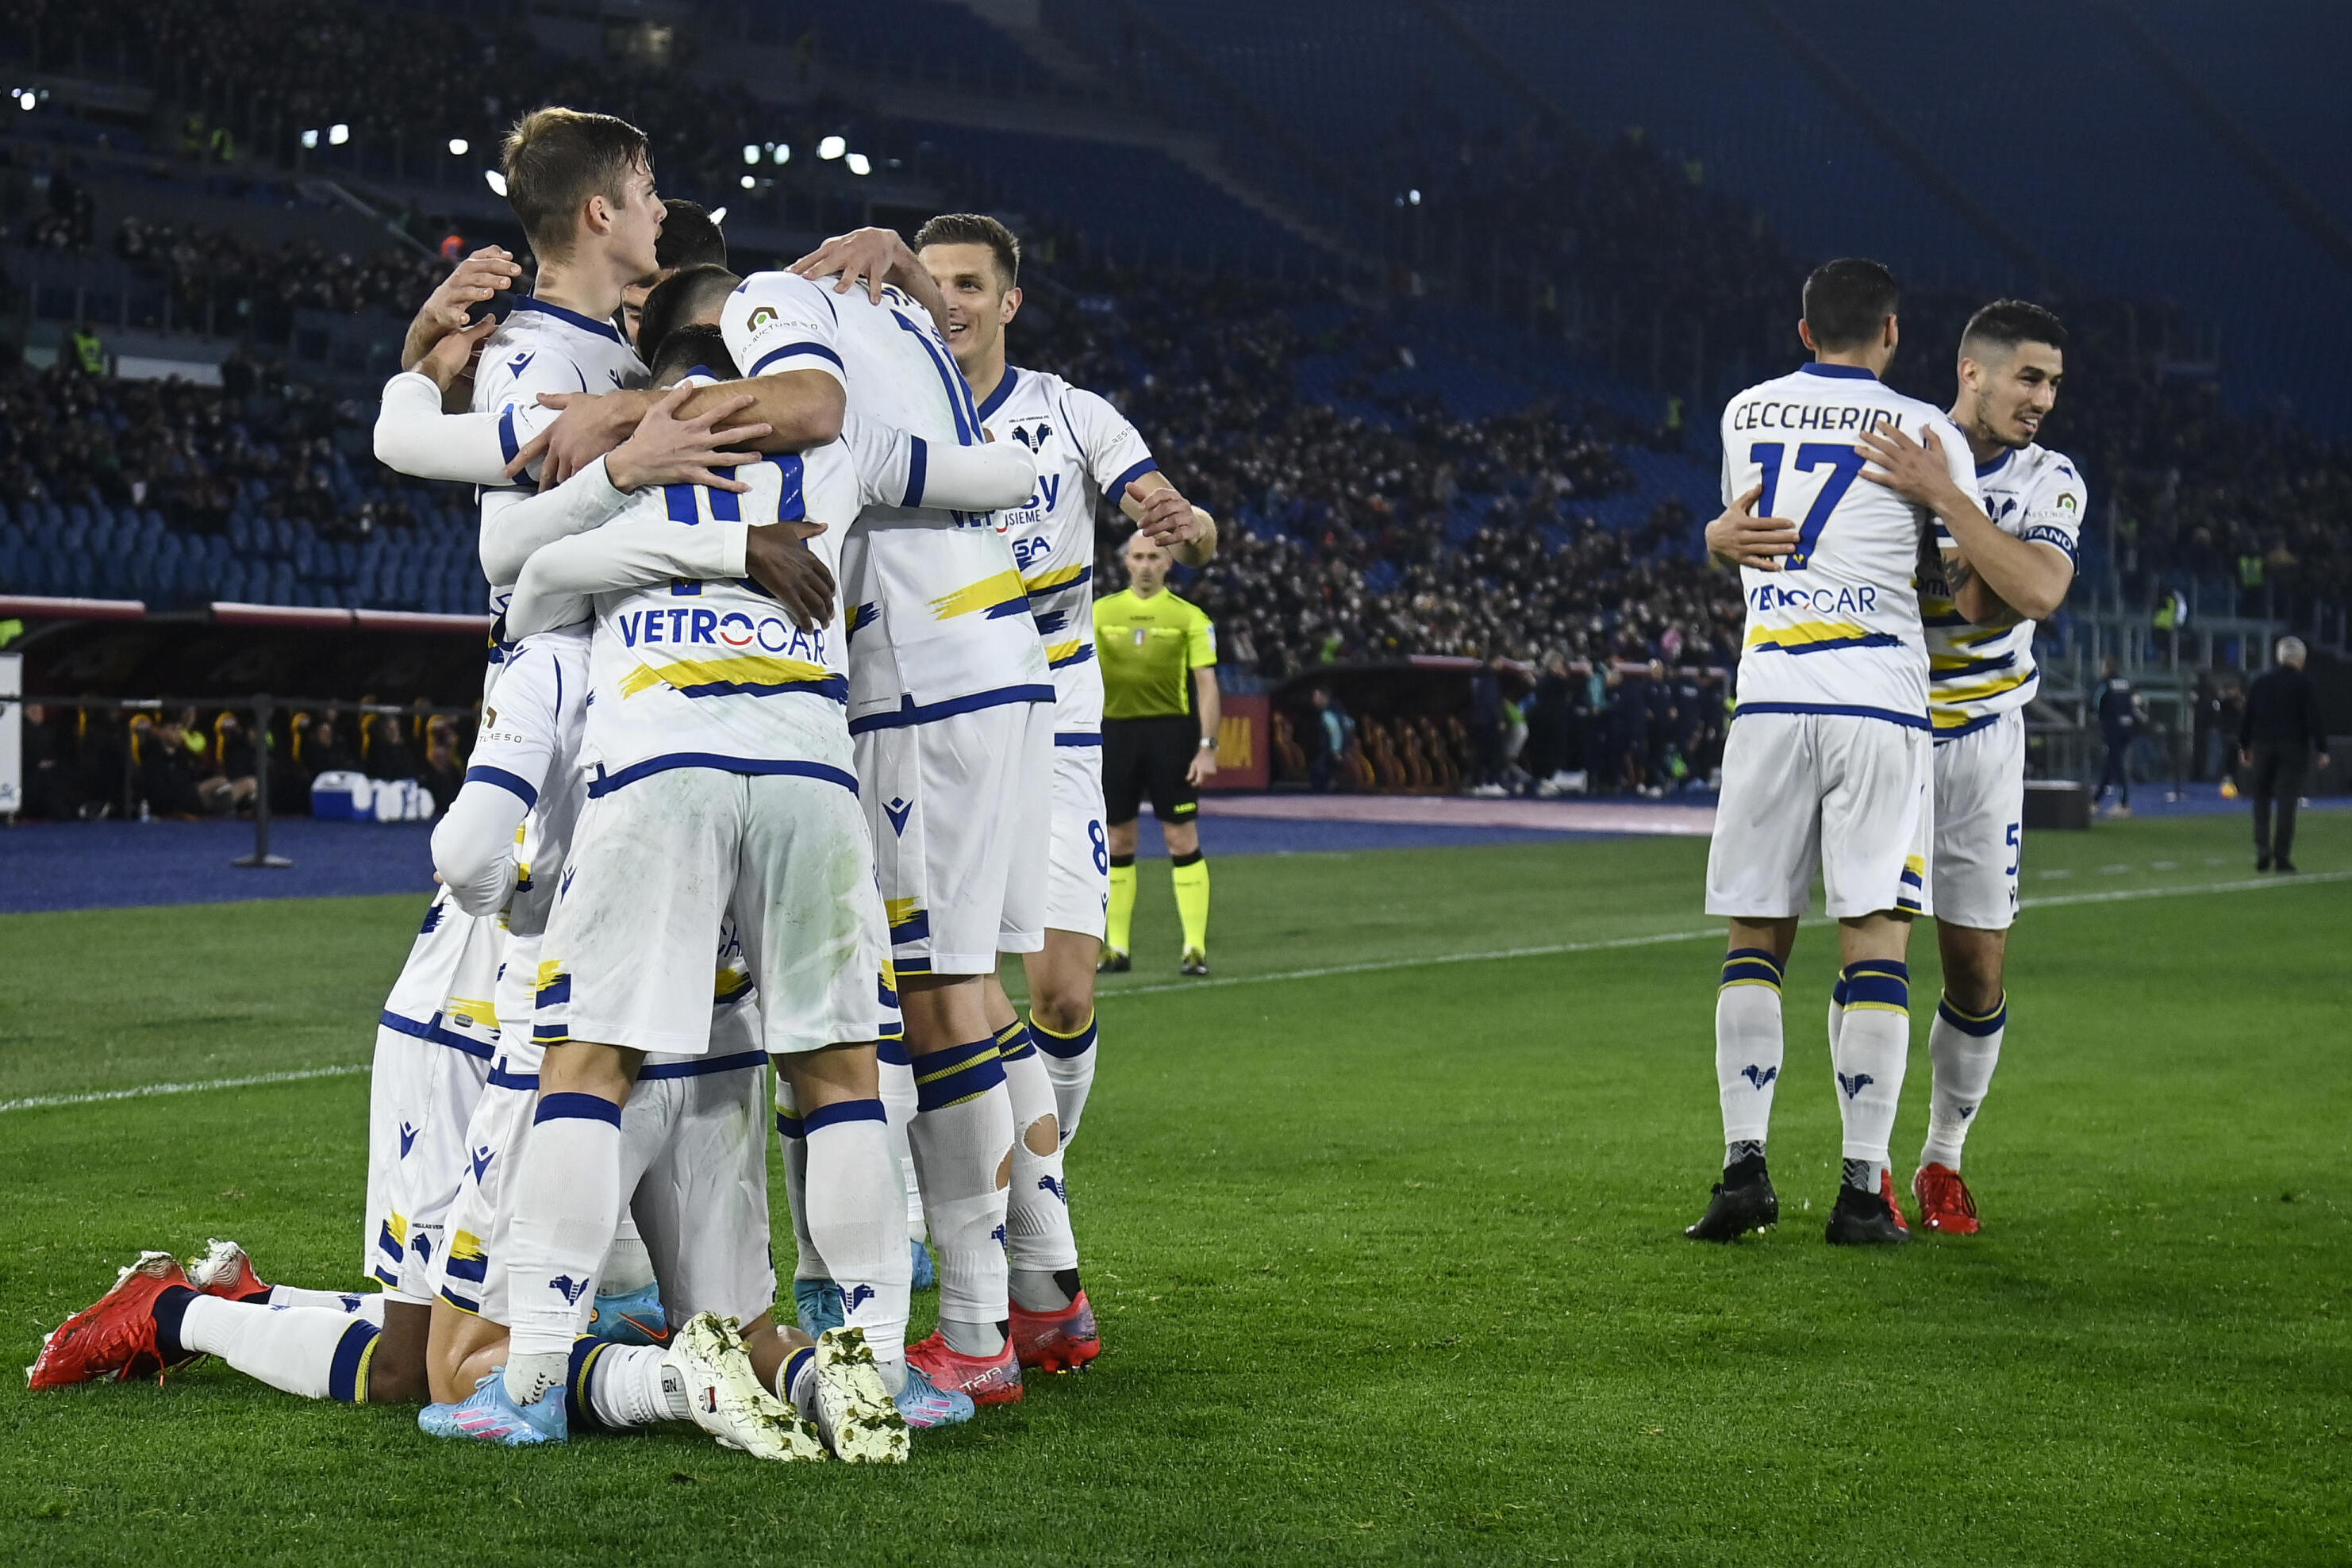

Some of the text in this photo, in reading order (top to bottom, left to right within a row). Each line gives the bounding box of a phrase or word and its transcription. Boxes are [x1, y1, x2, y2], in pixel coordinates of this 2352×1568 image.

[1750, 442, 1866, 571] 17
[619, 608, 828, 665] VETROCAR
[1088, 819, 1108, 876] 8
[2005, 821, 2019, 875] 5
